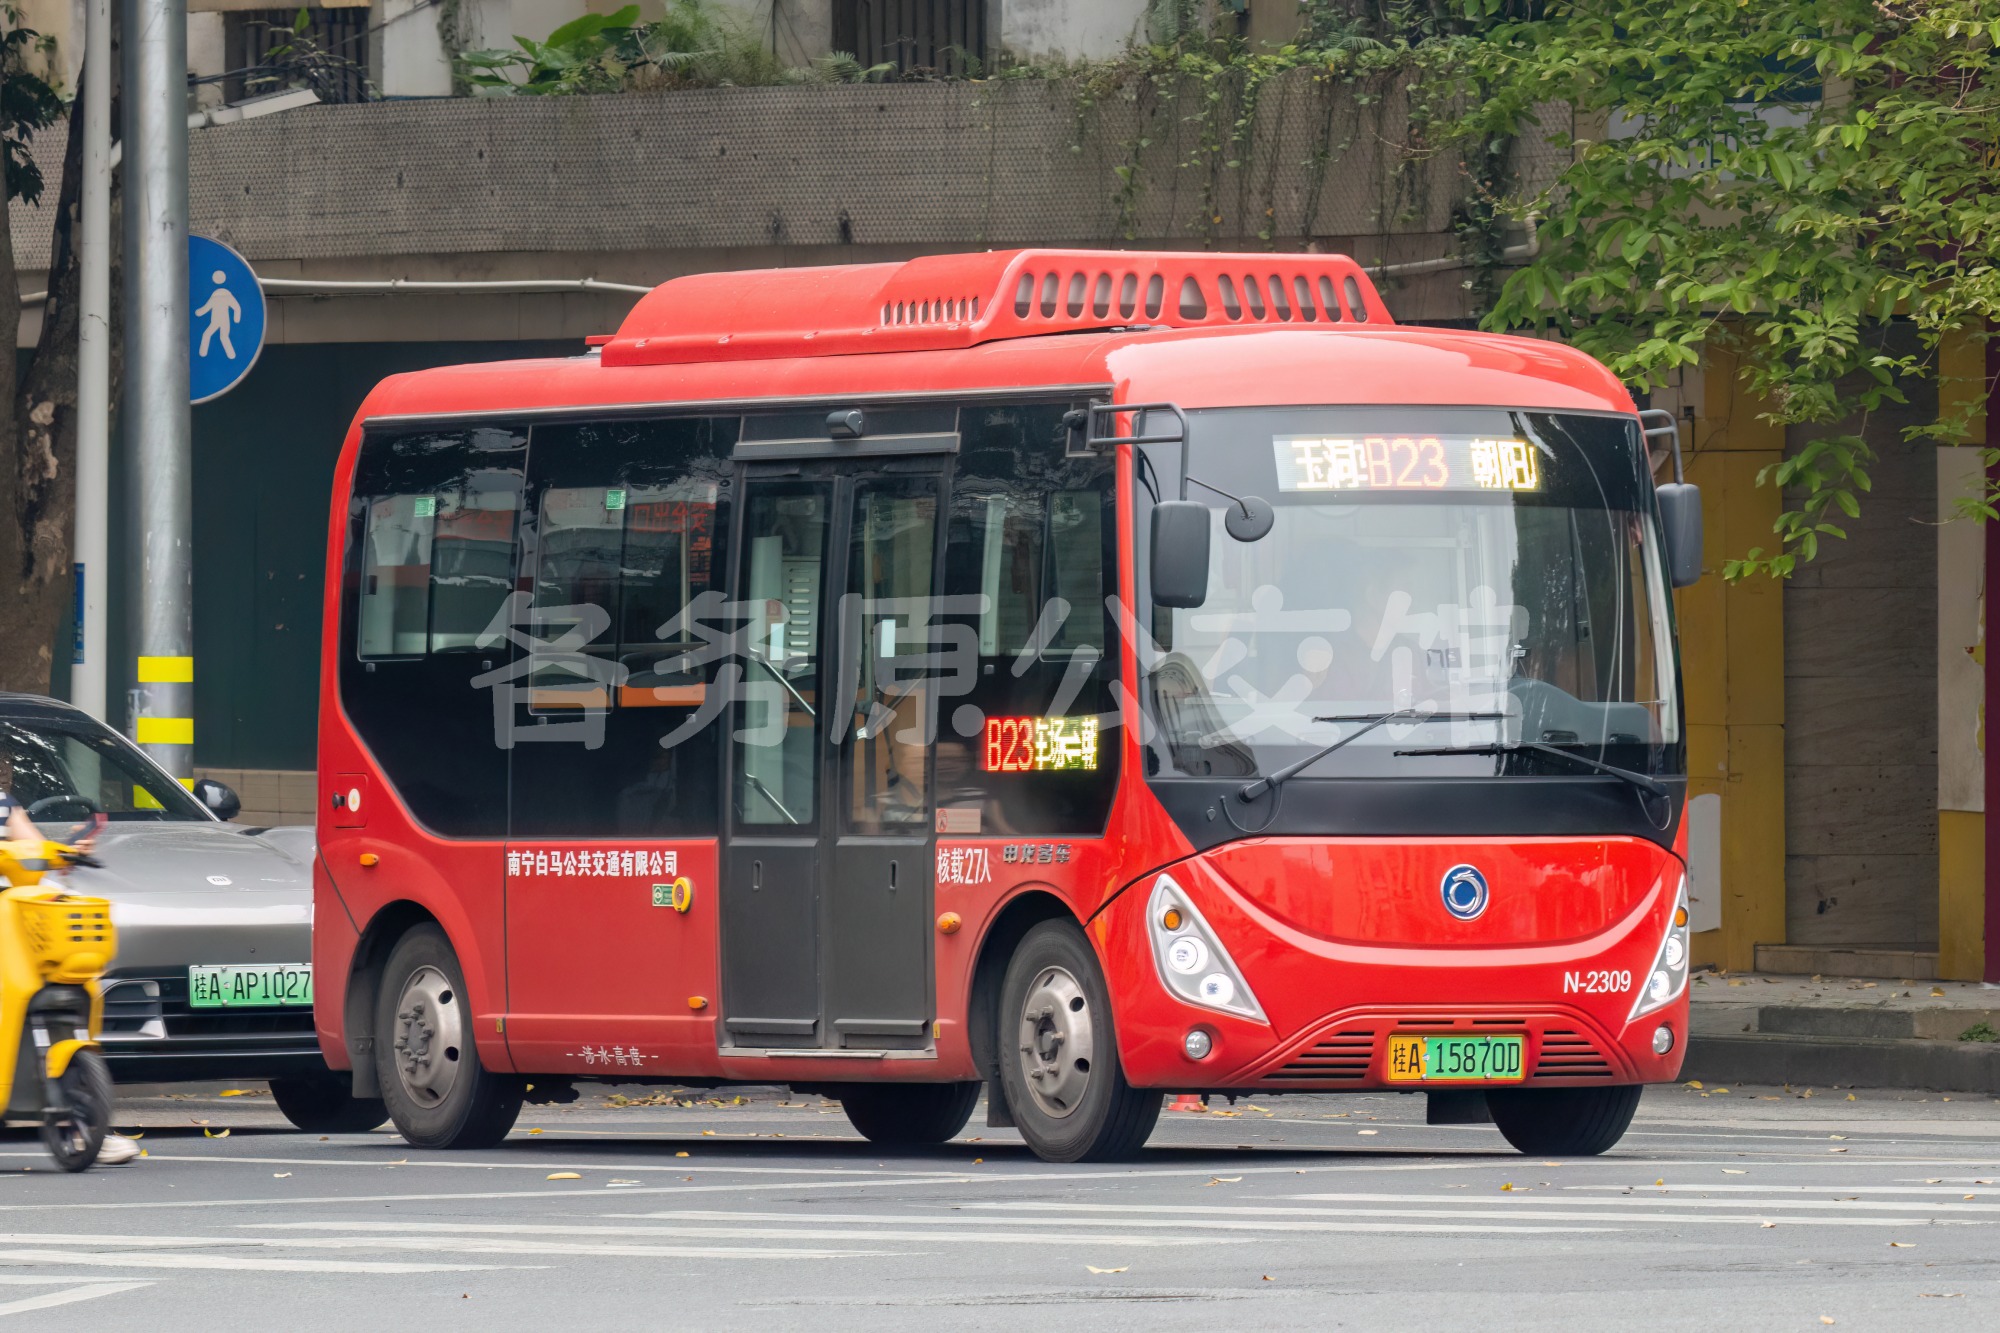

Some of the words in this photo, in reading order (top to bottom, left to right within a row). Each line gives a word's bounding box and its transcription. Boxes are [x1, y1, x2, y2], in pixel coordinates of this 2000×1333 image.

[1364, 437, 1449, 488] B23
[987, 718, 1034, 771] B23
[507, 850, 677, 877] 南宁白马公共交通有限公司
[937, 847, 992, 885] 核载27人
[1003, 844, 1072, 863] 申龙客车
[194, 973, 221, 1000] 桂A
[233, 971, 311, 999] AP1027
[1563, 970, 1632, 994] N-2309
[1393, 1043, 1421, 1073] 桂A
[1435, 1042, 1520, 1073] 15870D
